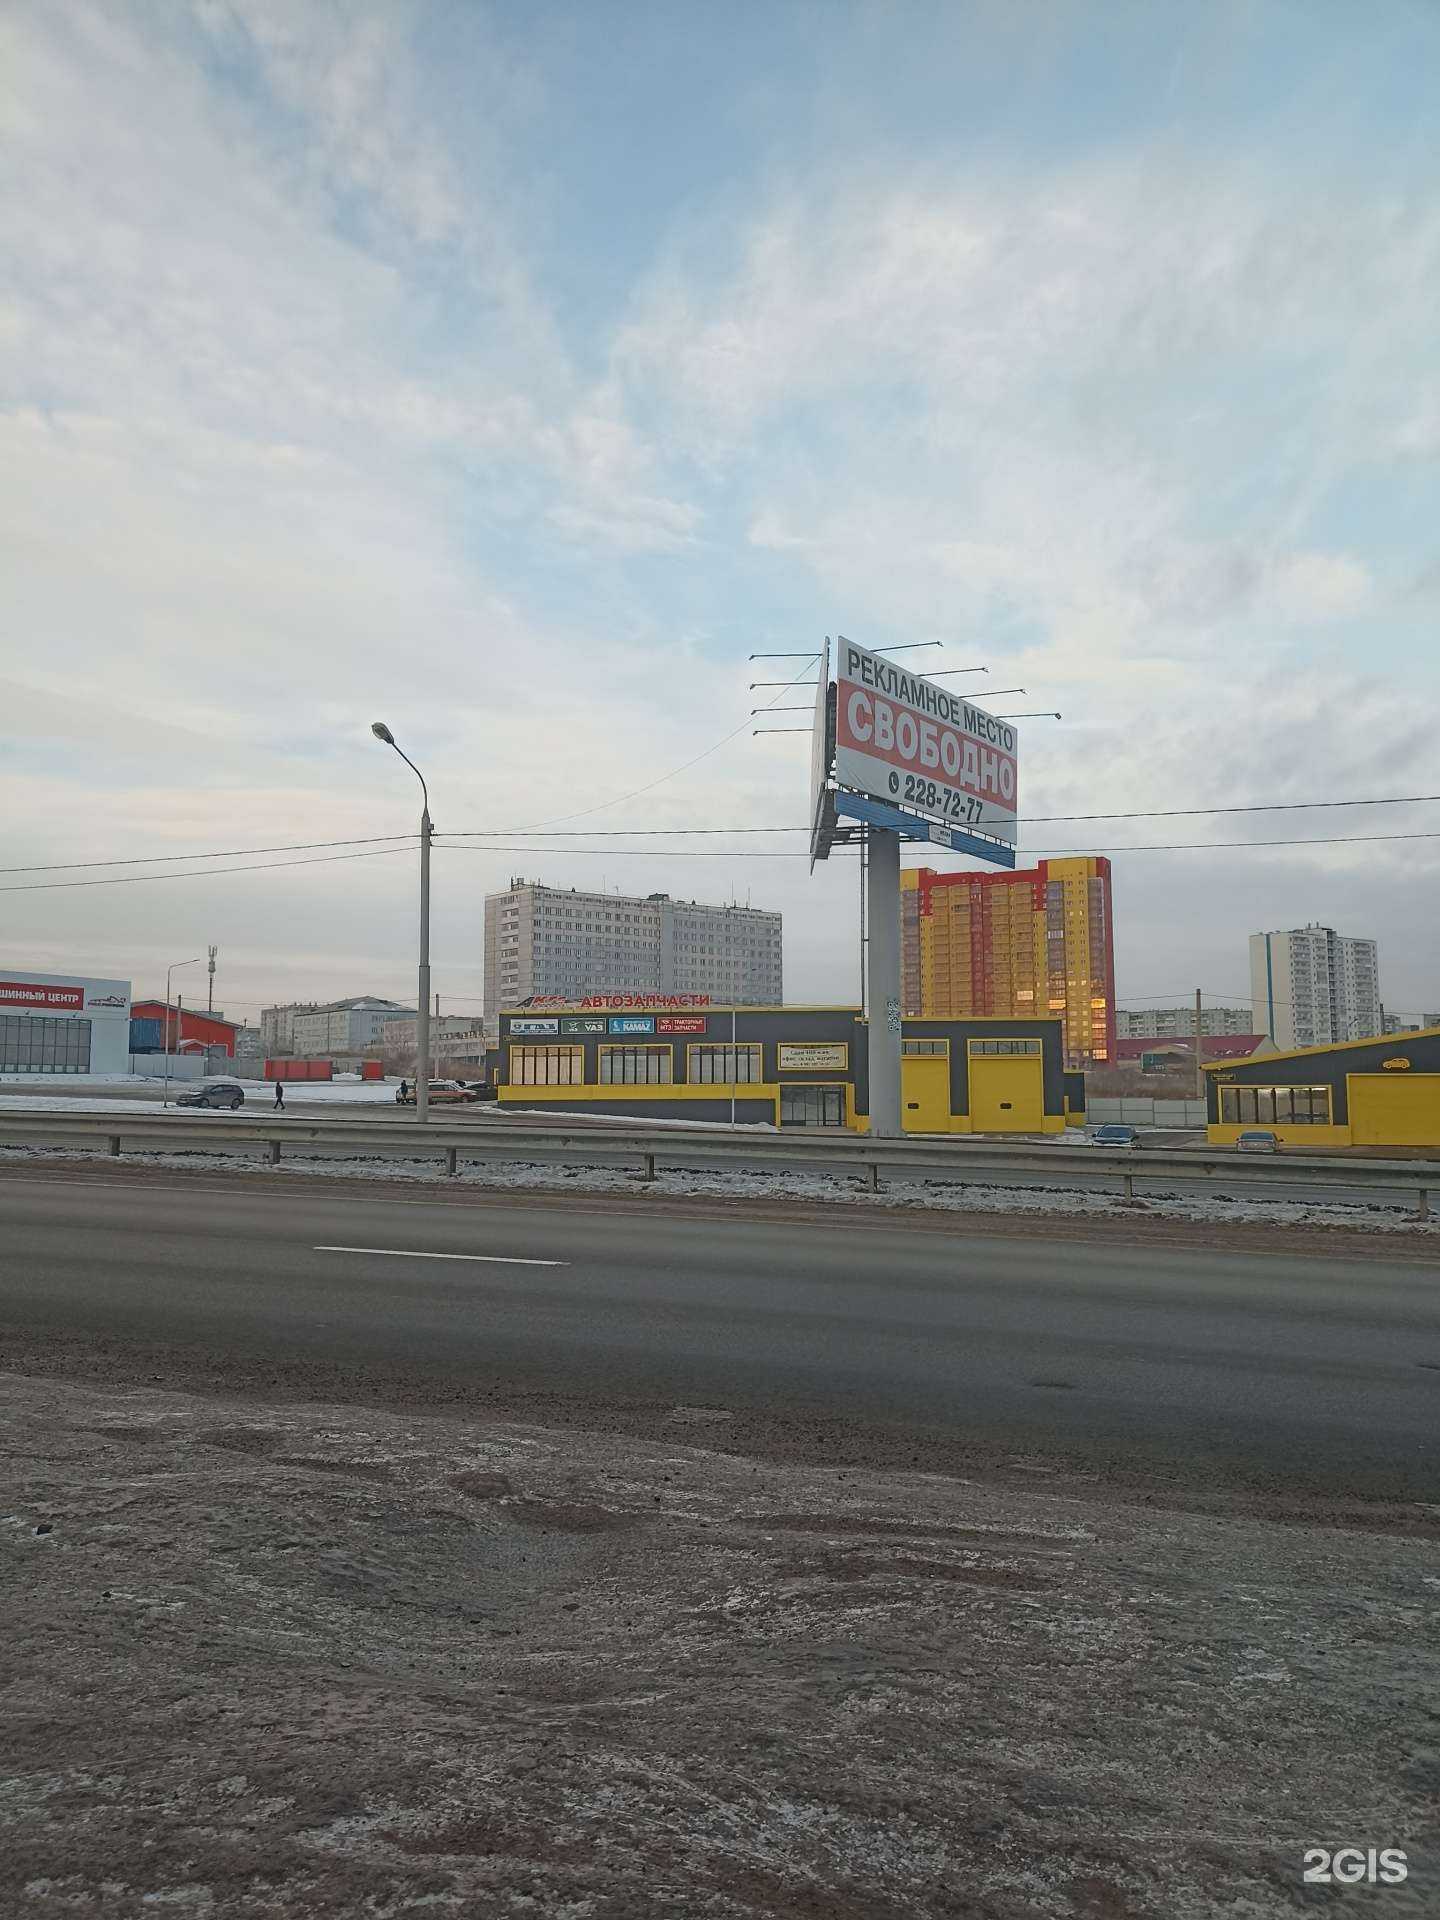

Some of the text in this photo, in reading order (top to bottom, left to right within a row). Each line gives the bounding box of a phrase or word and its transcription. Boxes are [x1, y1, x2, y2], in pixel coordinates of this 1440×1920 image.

[847, 648, 1014, 752] РЕКЛАМНОЕ МЕСТО
[847, 691, 1015, 801] СВОБОДНО
[904, 775, 983, 824] 228-72-77
[48, 993, 79, 1003] ЦЕНТР
[580, 993, 710, 1008] АВТОЗАПЧАСТИ
[622, 1023, 651, 1032] KAMAZ
